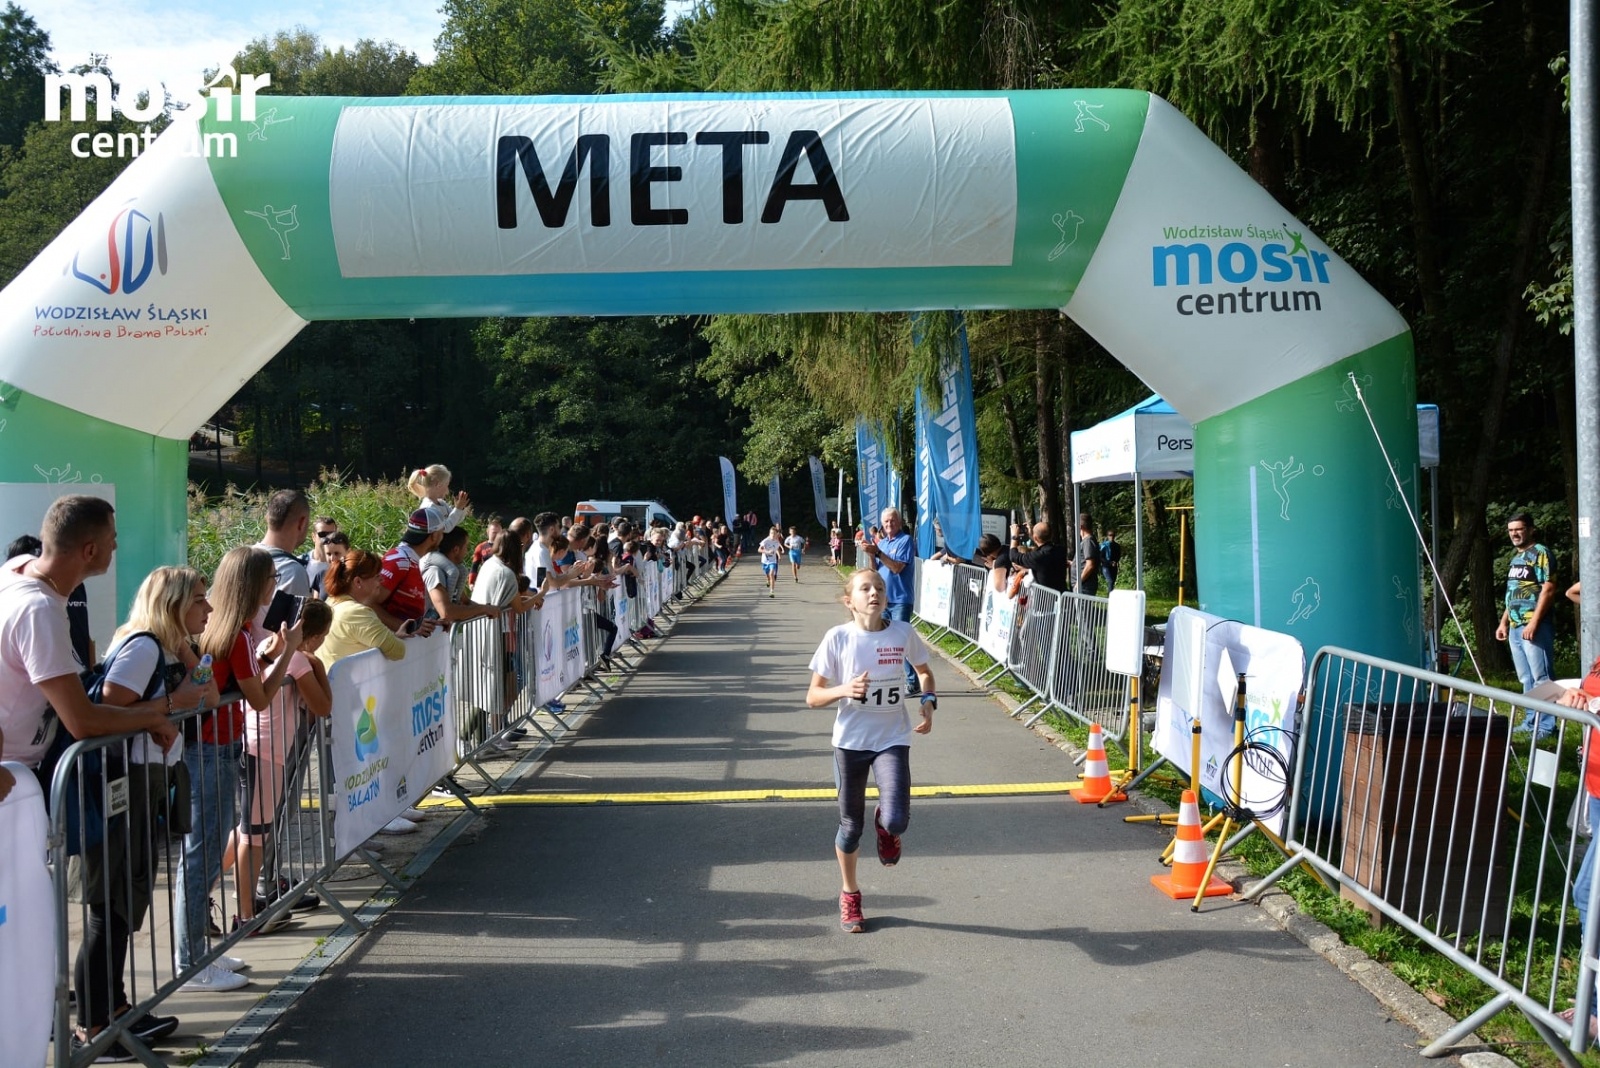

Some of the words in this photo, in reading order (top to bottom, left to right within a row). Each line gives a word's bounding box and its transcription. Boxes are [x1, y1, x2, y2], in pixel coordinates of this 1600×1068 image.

[496, 130, 850, 229] META
[1162, 225, 1243, 240] Wodzisław
[1247, 223, 1284, 242] Śląski
[1152, 242, 1331, 287] mosir
[35, 304, 141, 320] WODZISŁAW
[147, 303, 208, 324] ŚLĄSKI
[1176, 286, 1322, 316] centrum
[33, 325, 111, 338] Południowa
[116, 325, 161, 339] Brama
[412, 684, 448, 737] mosr
